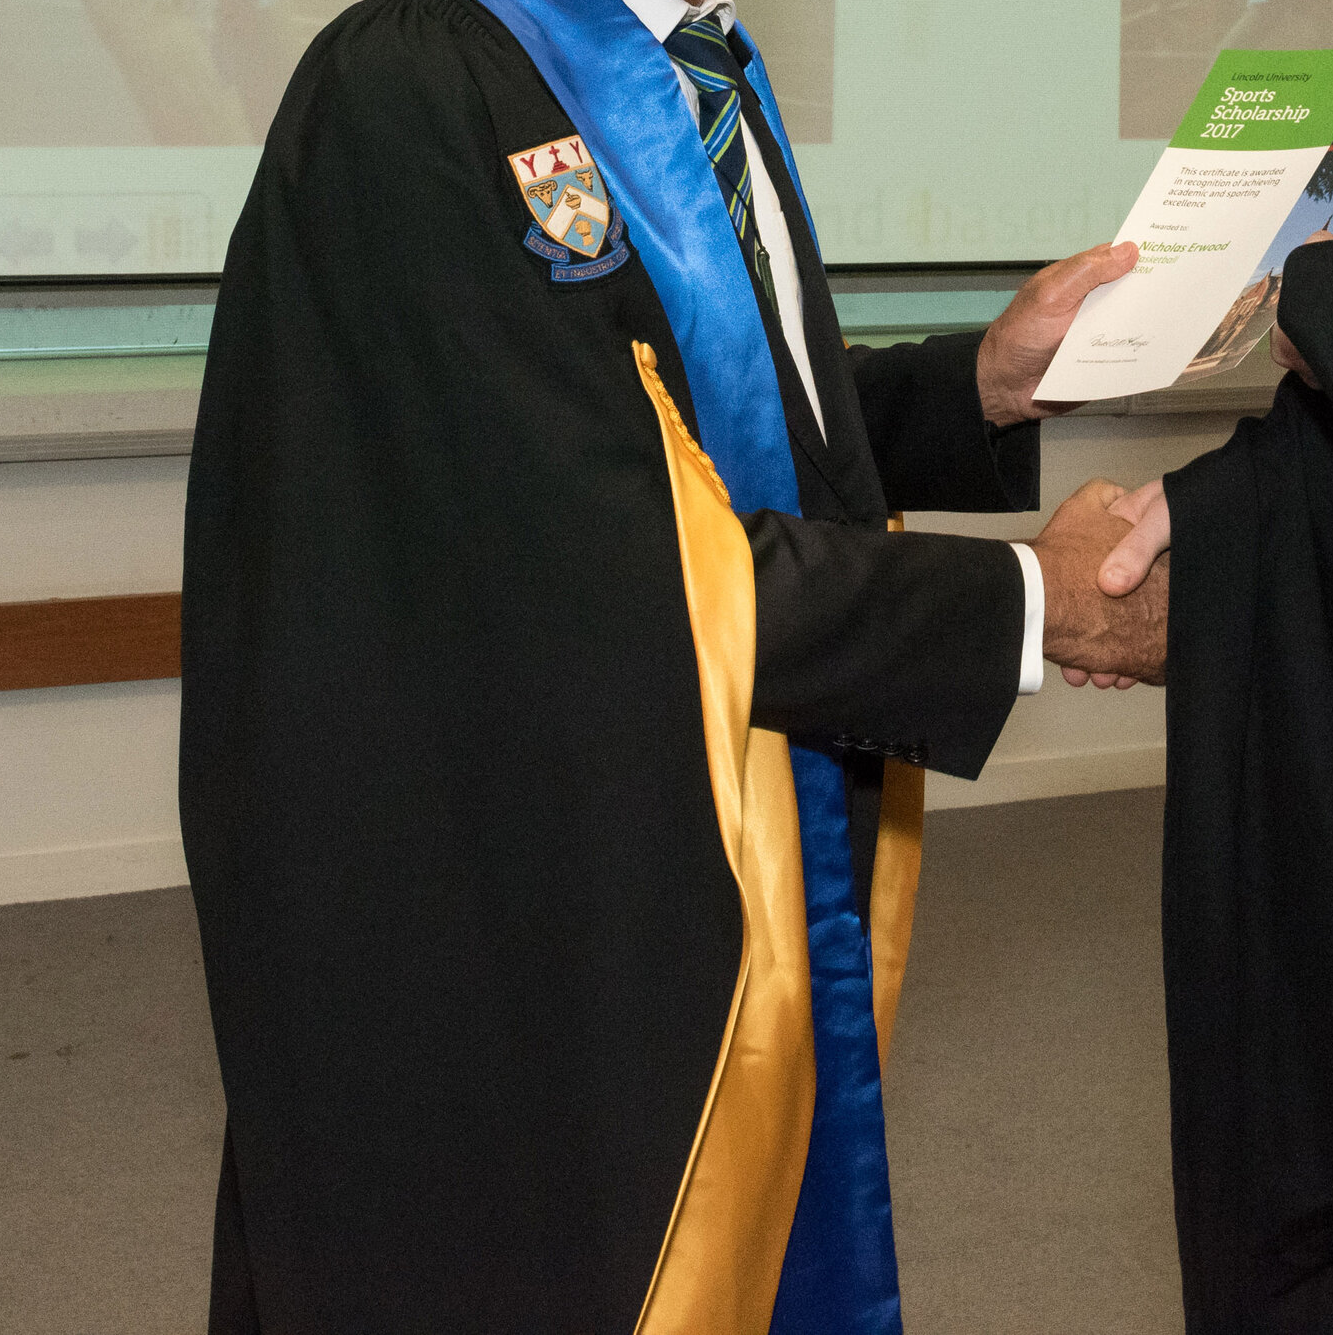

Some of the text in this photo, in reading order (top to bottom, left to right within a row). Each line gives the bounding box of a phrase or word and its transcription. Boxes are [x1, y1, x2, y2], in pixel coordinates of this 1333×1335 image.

[1231, 72, 1313, 83] Lincoln University
[1220, 86, 1276, 105] Sports
[1210, 104, 1311, 124] Scholarship
[1200, 122, 1245, 139] 2017
[1180, 166, 1287, 177] This certificate is awarded
[1173, 177, 1281, 189] in recognition of achieving
[1168, 188, 1261, 199] academic and sporting
[1162, 198, 1207, 208] excellence
[1149, 222, 1179, 232] Awarded
[1138, 239, 1232, 253] Nicholas Erwood
[1136, 254, 1181, 264] asketball
